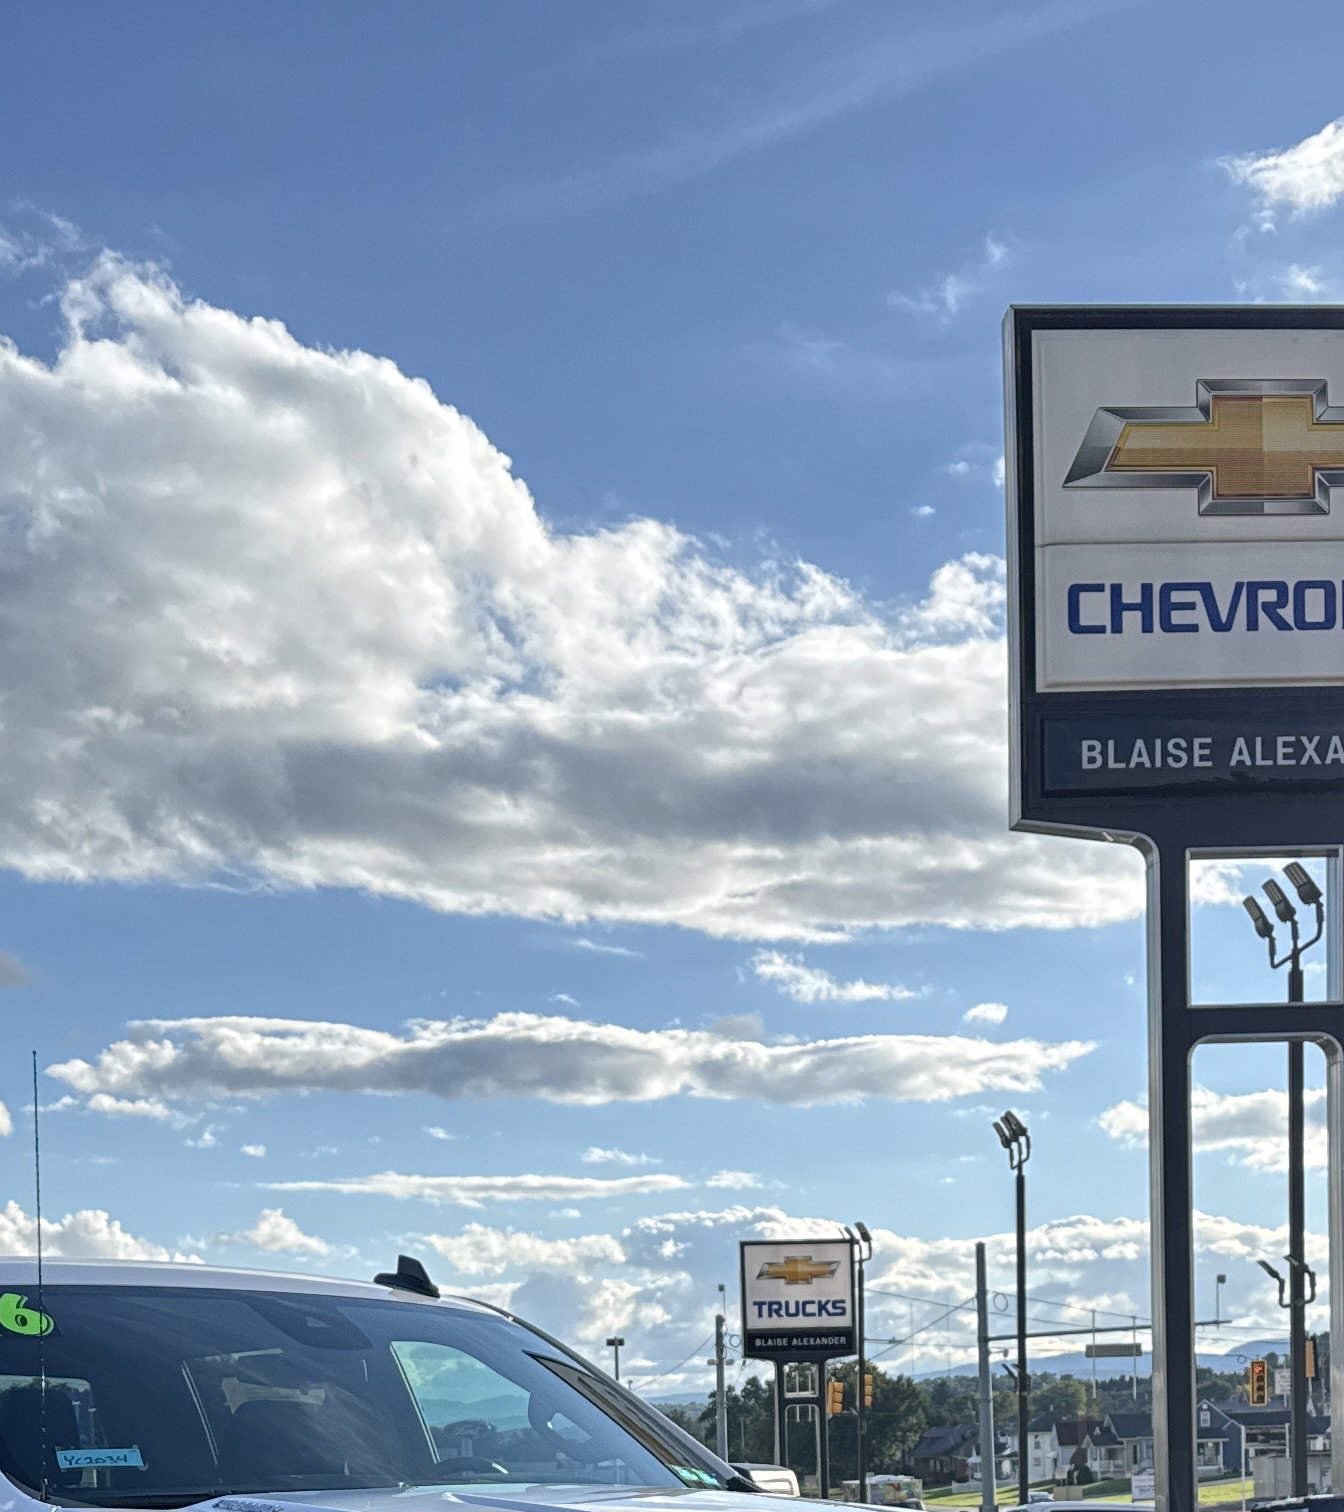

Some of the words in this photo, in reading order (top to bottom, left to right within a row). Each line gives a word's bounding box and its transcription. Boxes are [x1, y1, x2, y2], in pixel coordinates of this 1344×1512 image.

[1082, 737, 1213, 770] BLAISE
[753, 1299, 847, 1318] TRUCKS
[755, 1339, 788, 1347] BLAISE
[792, 1336, 847, 1345] ALEXANDER
